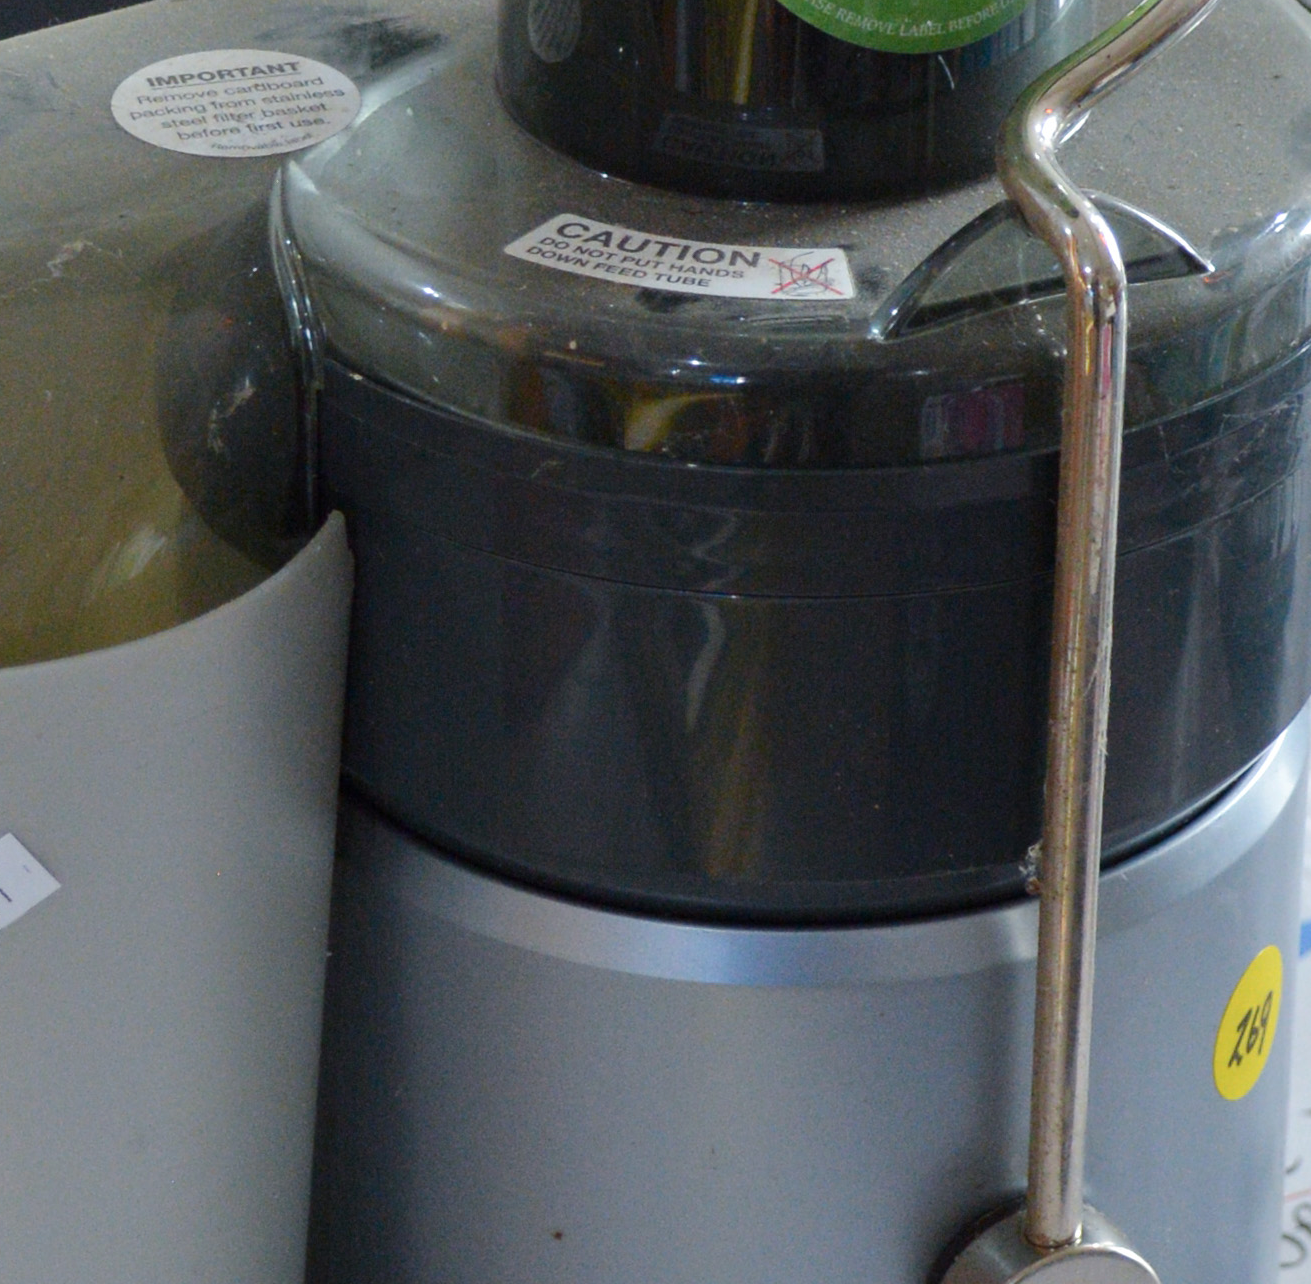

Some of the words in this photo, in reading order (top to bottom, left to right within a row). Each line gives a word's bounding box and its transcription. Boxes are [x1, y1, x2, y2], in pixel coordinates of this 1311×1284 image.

[837, 7, 894, 36] REMOVE
[899, 21, 946, 37] LABEL
[949, 4, 998, 31] BEFORE
[146, 61, 300, 87] IMPORTANT
[130, 102, 207, 121] packing
[211, 97, 256, 111] from
[262, 87, 345, 105] stainless
[136, 88, 218, 106] Remove
[224, 76, 324, 98] cardboard
[161, 115, 207, 129] steel
[213, 110, 255, 124] filter
[260, 102, 328, 118] basket
[177, 126, 242, 141] before
[246, 120, 284, 134] first
[540, 237, 569, 250] DO
[576, 242, 620, 262] NOT
[624, 255, 664, 269] PUT
[670, 262, 744, 279] HANDS
[557, 222, 761, 268] CAUTION
[527, 246, 589, 269] DOWN
[594, 262, 648, 279] FEED
[655, 272, 712, 288] TUBE
[1228, 990, 1273, 1068] 269
